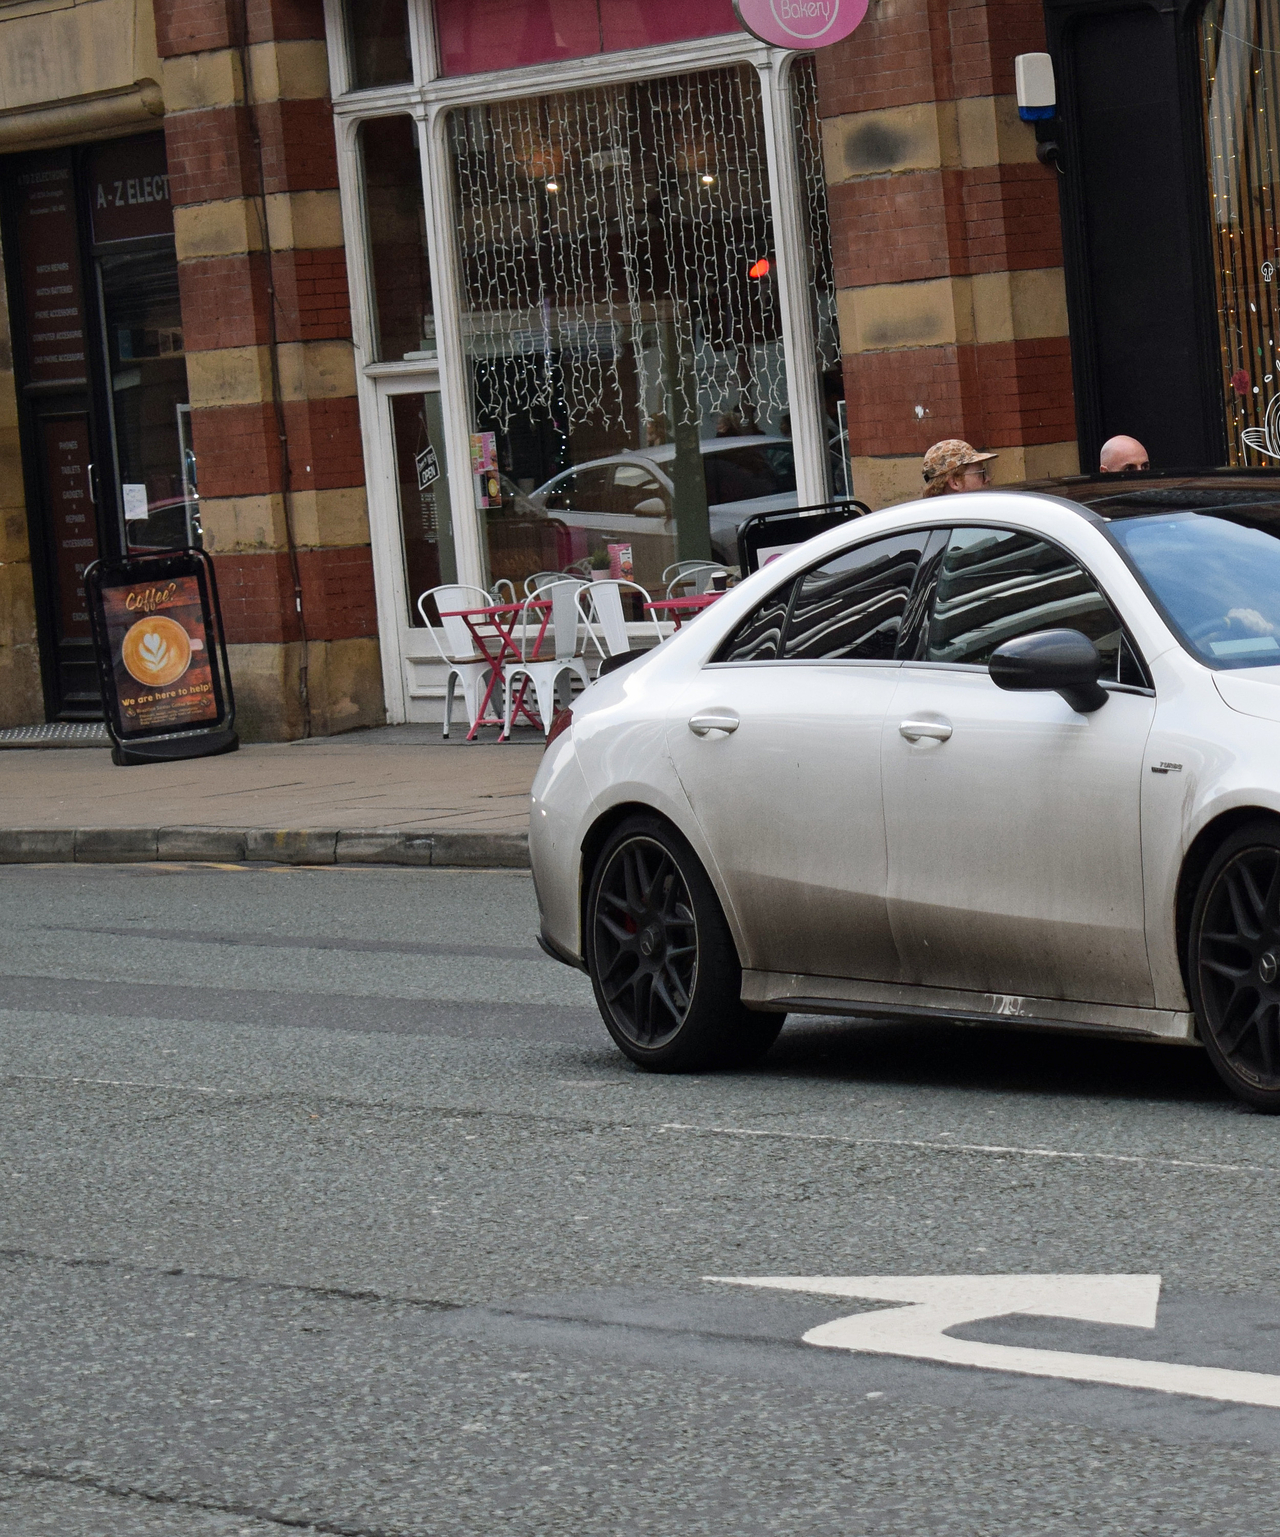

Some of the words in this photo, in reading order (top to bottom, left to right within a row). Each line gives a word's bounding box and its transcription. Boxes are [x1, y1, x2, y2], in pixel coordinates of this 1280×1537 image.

[781, 1, 830, 21] Bakery
[127, 174, 169, 204] ELECT
[421, 464, 436, 484] OPEN
[125, 582, 177, 612] Coffee?
[121, 698, 135, 707] We
[137, 694, 153, 703] are
[155, 690, 176, 700] here
[178, 688, 188, 696] to
[190, 682, 212, 693] help!
